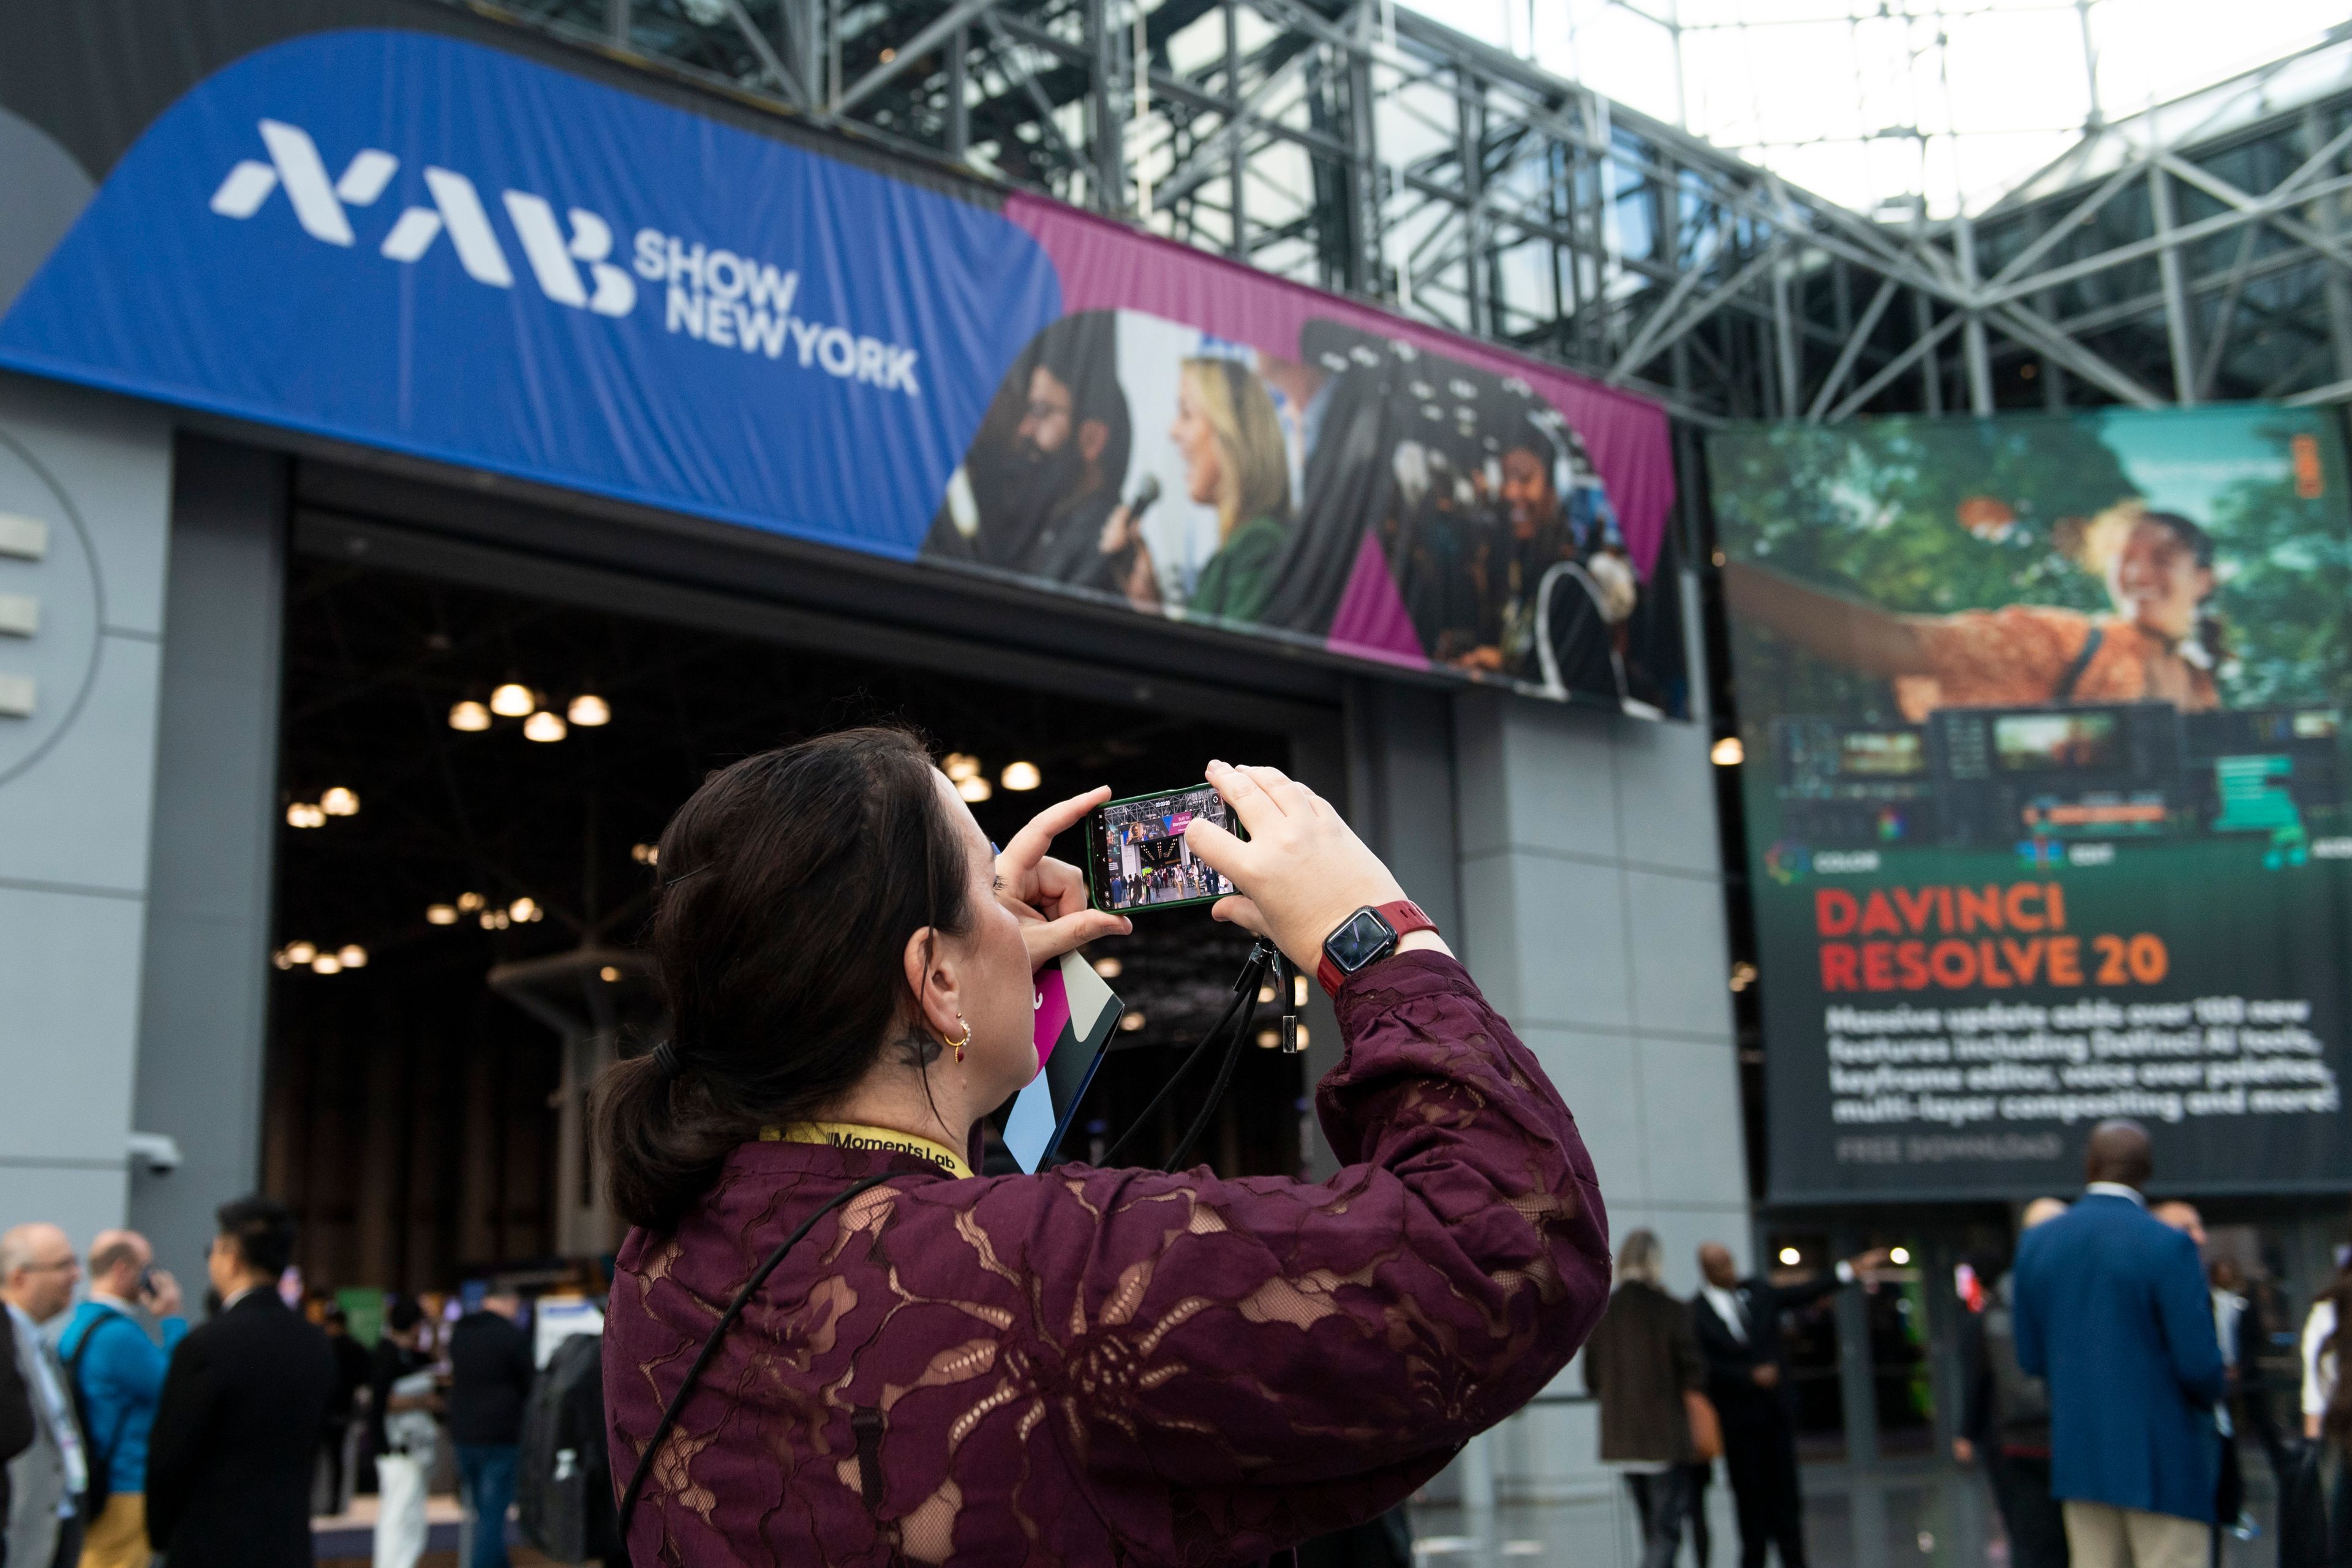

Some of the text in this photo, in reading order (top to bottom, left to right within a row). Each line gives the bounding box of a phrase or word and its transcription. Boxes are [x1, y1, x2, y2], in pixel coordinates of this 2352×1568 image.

[209, 119, 637, 318] NAB
[633, 228, 799, 314] SHOW
[666, 285, 919, 397] NEW YORK
[1814, 851, 1880, 872] COLOR
[1816, 882, 2065, 936] DAVINCI
[1820, 933, 2168, 991] RESOLVE 20
[1826, 1005, 1940, 1033] Massive
[1945, 1002, 2046, 1033] update
[2052, 1000, 2122, 1028] adds
[2128, 1004, 2191, 1025] over
[2247, 1001, 2310, 1022] new
[1829, 1033, 1950, 1062] features
[1955, 1031, 2087, 1063] including
[2092, 1028, 2201, 1057] DaVinci
[1831, 1063, 1962, 1095] keyframe
[2062, 1061, 2136, 1085] voice
[2139, 1063, 2203, 1084] over
[1833, 1095, 1996, 1127] multi-layer
[2001, 1089, 2183, 1125] compositing
[2187, 1087, 2244, 1113] and
[834, 1133, 956, 1170] Moments Lab
[1838, 1134, 2063, 1161] FREE DOWNLOAD
